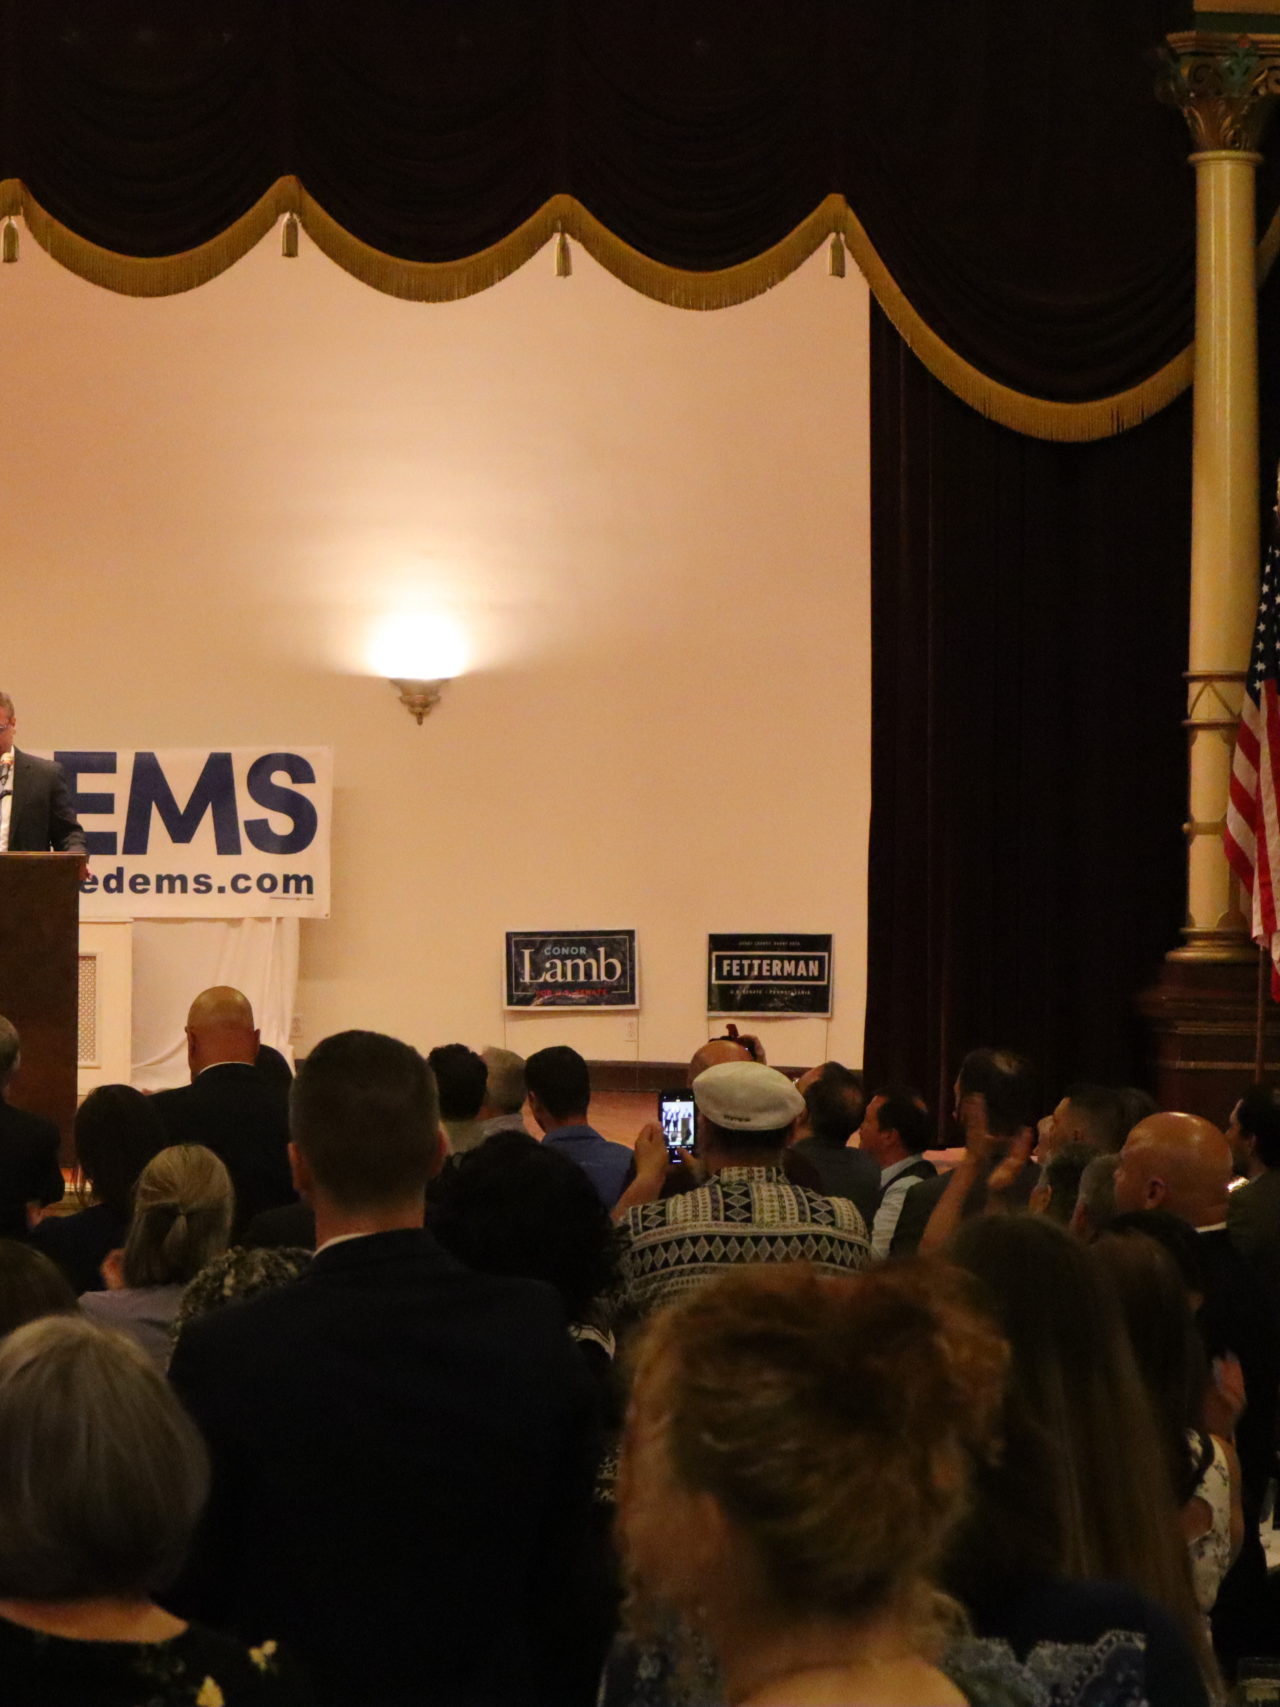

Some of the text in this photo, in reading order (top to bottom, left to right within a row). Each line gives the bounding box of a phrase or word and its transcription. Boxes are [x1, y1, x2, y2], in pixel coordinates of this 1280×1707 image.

[544, 946, 587, 955] CONOR
[520, 946, 622, 983] Lamb
[722, 959, 819, 977] FETTERMAN
